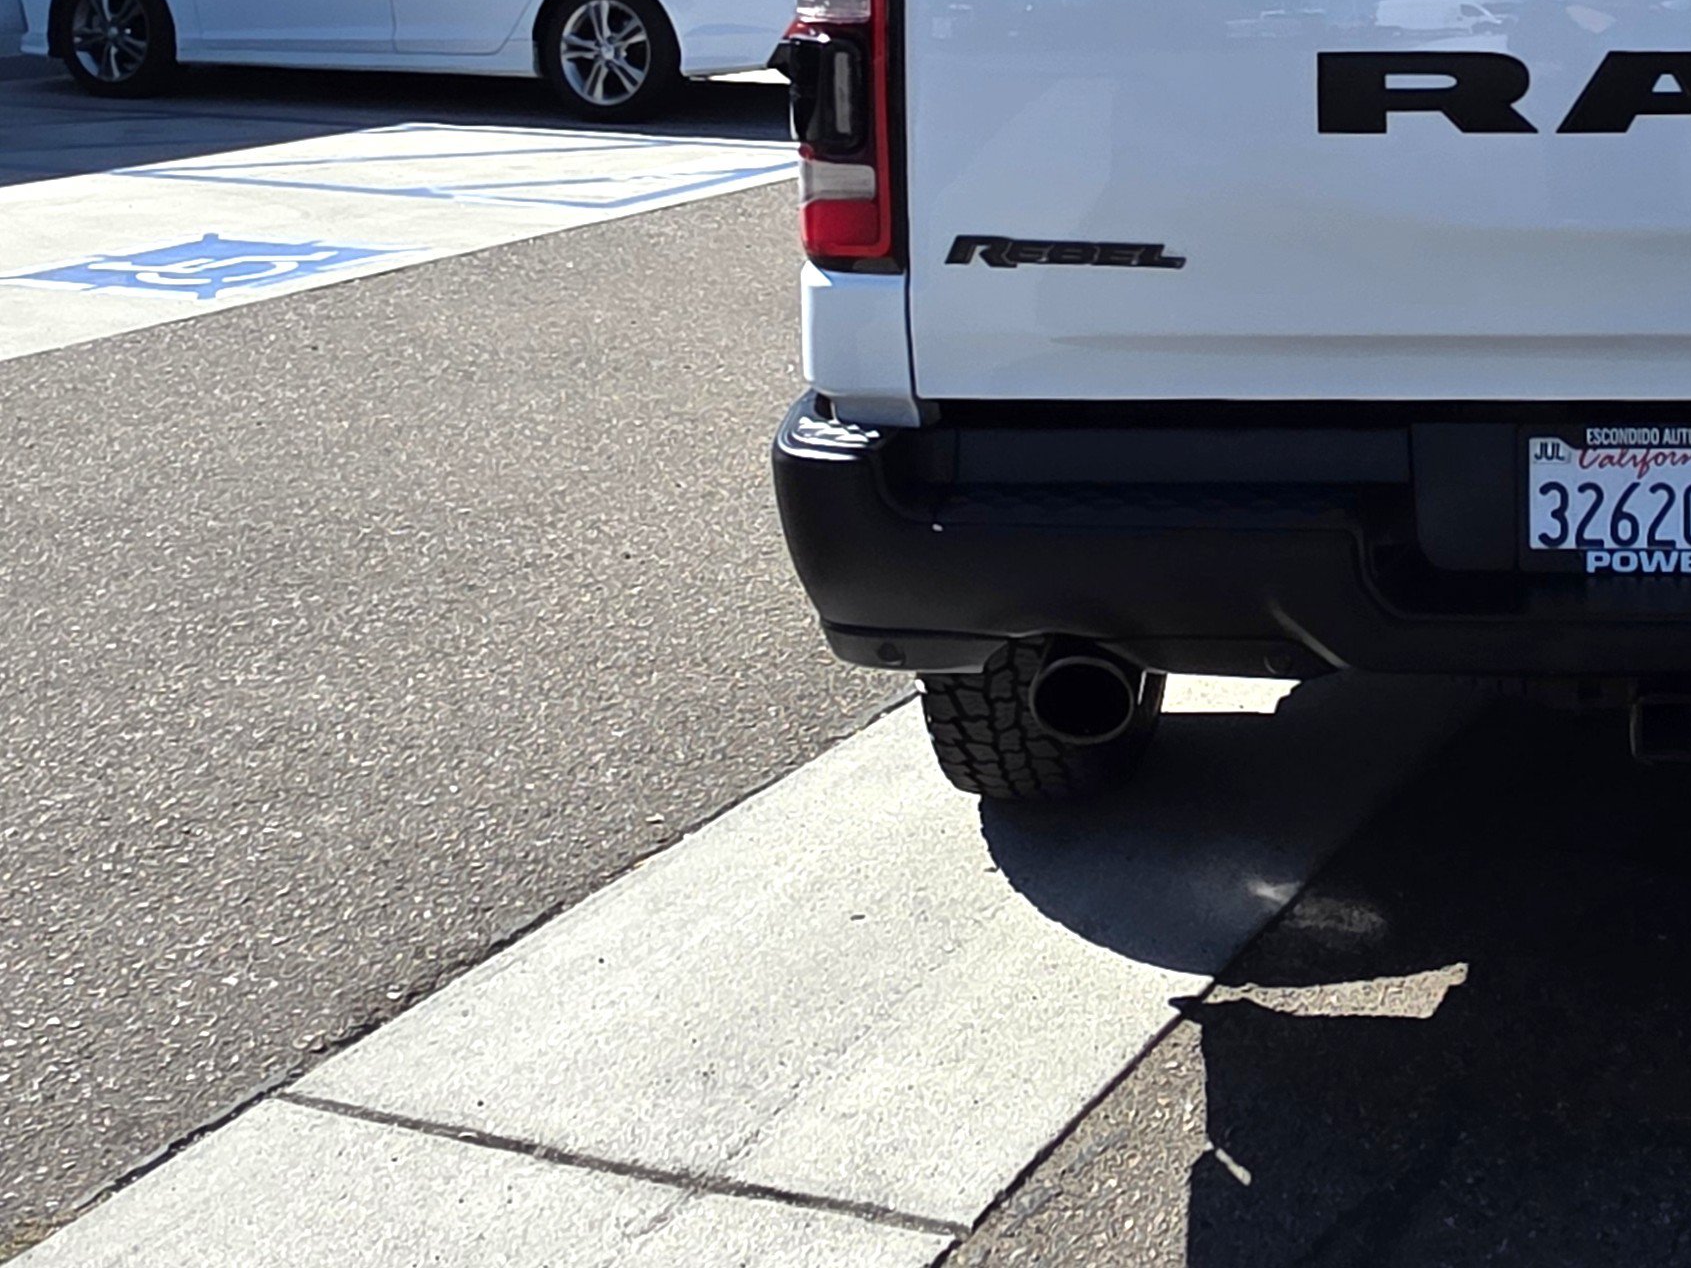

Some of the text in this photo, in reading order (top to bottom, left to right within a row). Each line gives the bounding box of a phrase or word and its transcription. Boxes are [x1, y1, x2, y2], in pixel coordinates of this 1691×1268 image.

[944, 235, 1187, 270] REBEL
[1586, 428, 1660, 446] ESCONDIDO
[1533, 442, 1566, 462] JUL
